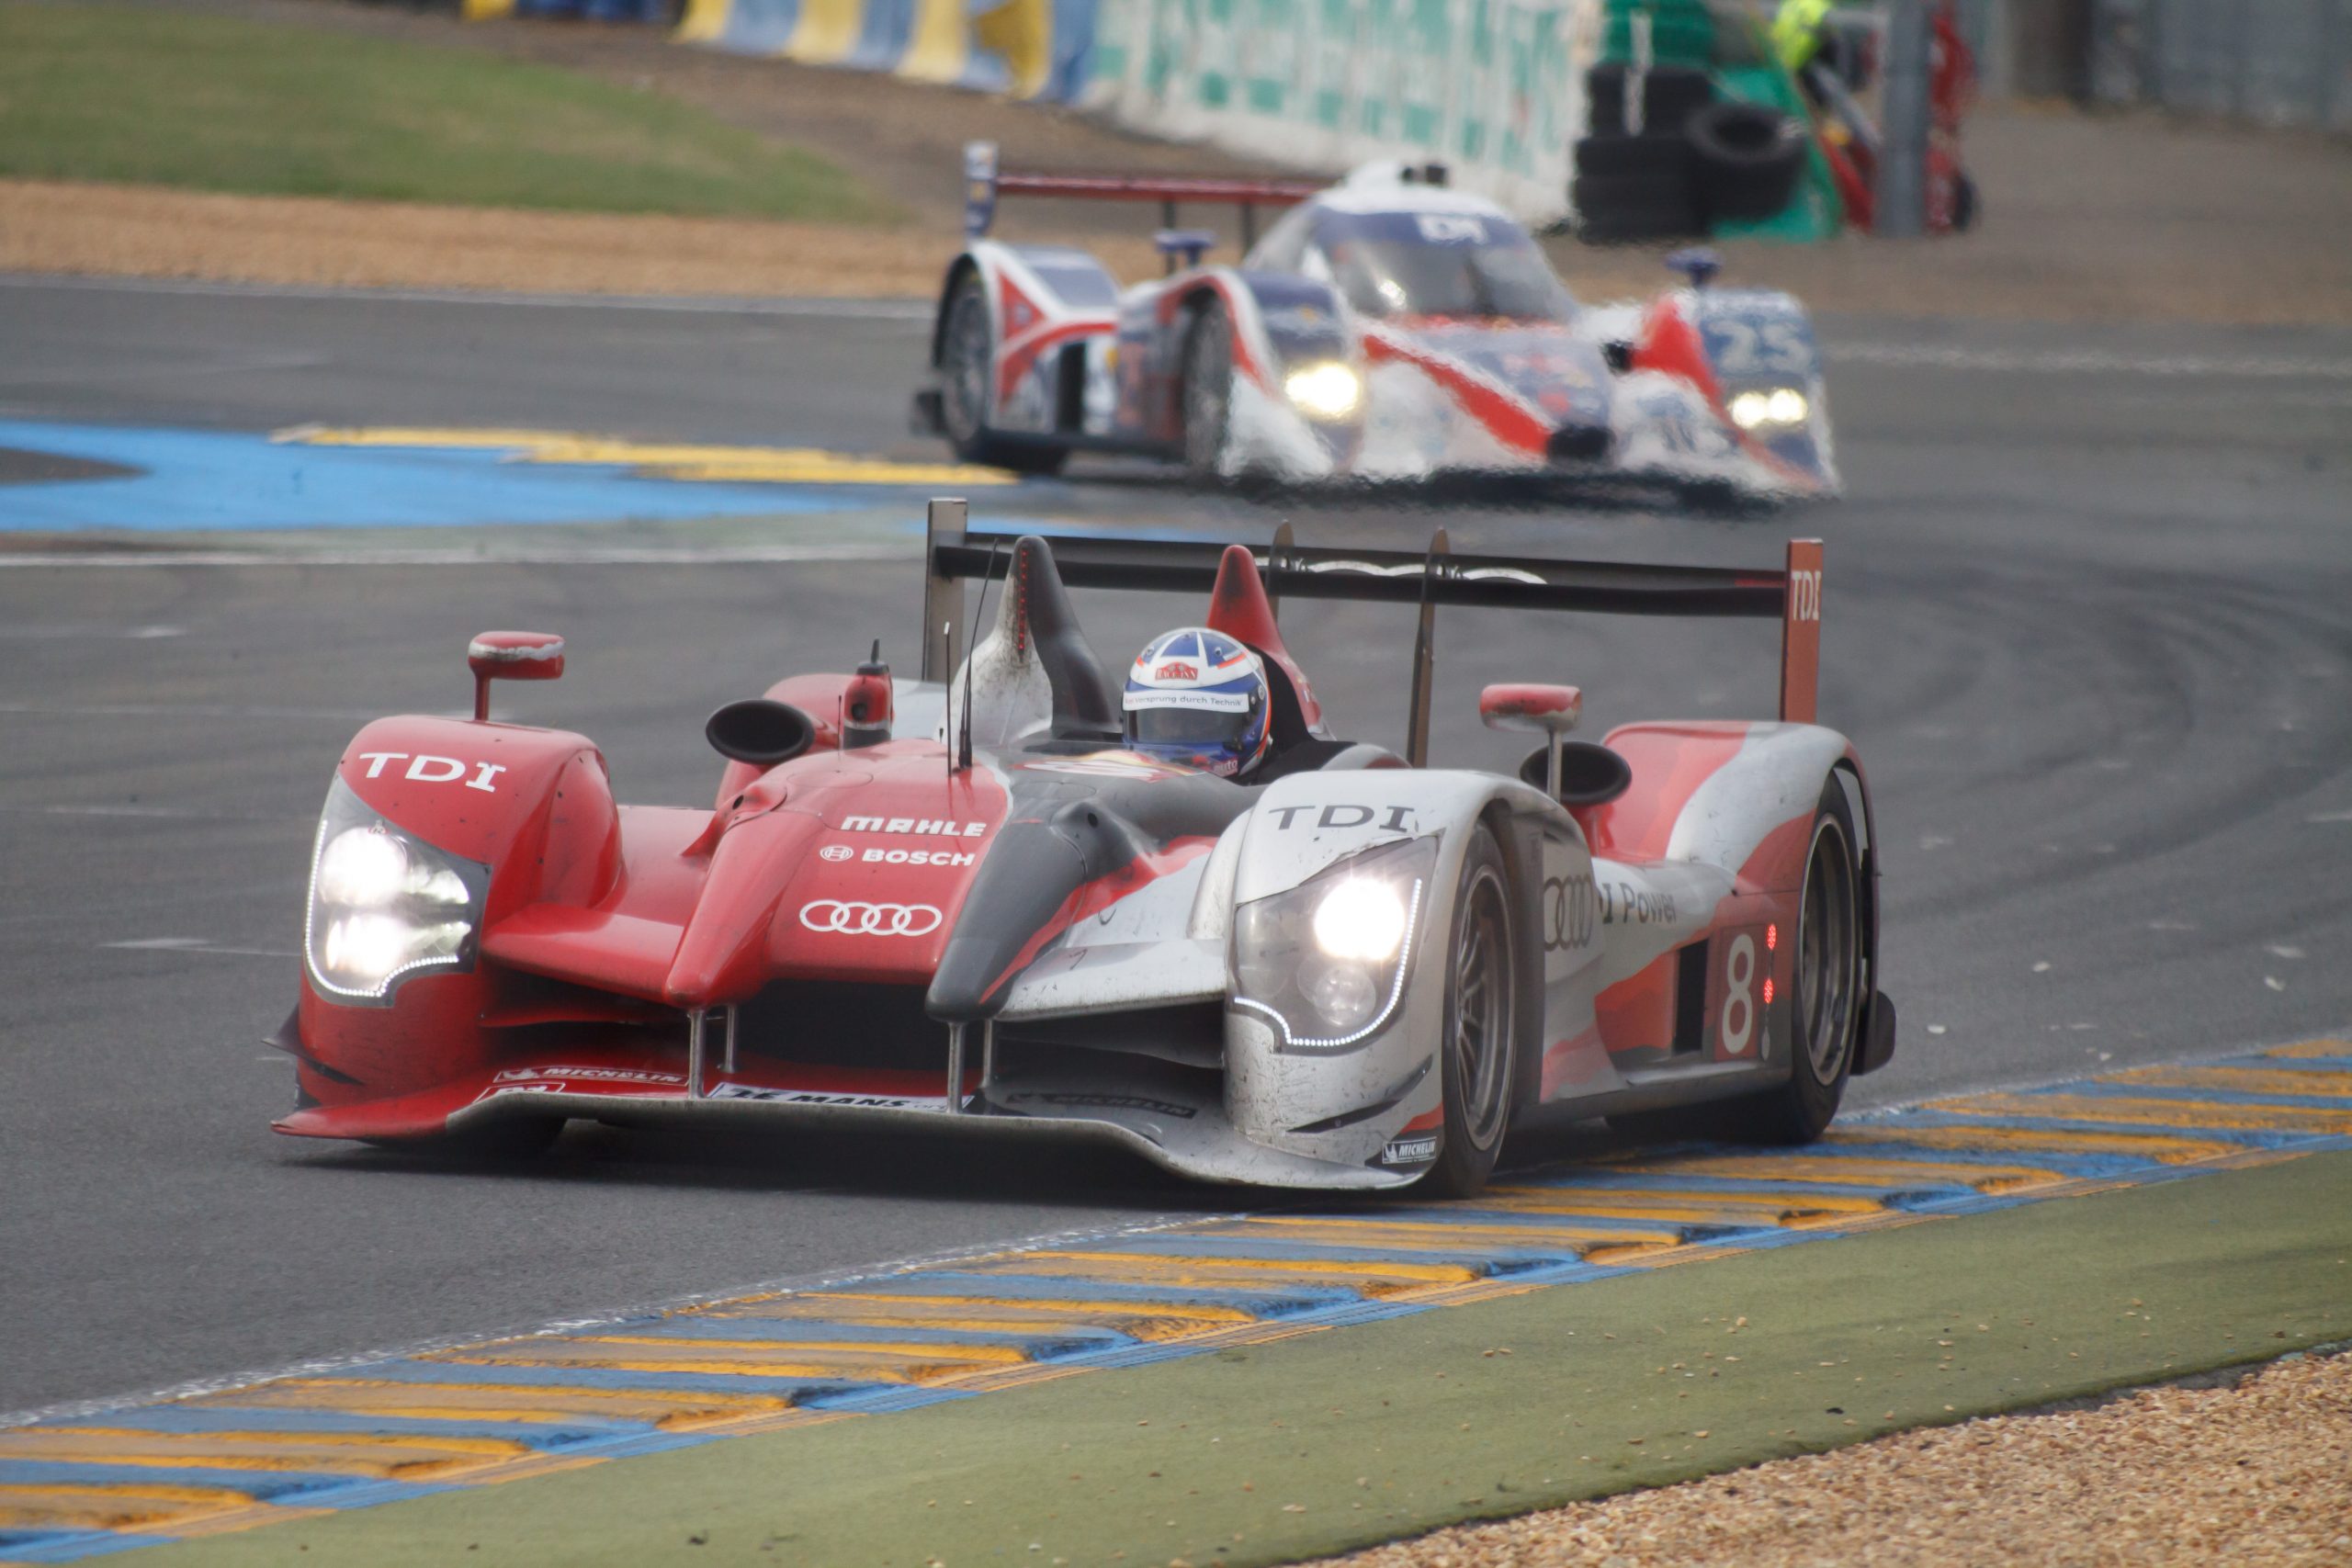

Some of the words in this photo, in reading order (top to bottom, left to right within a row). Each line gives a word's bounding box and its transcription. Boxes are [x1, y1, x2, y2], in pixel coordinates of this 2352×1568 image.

[1707, 321, 1813, 372] 25
[1791, 570, 1822, 621] TDI
[1180, 695, 1208, 705] durch
[1210, 697, 1243, 706] Technik
[358, 752, 507, 793] TDI
[840, 816, 987, 838] MAHLE
[1268, 805, 1414, 832] TDI
[861, 849, 977, 866] BOSCH
[1618, 883, 1677, 924] Power
[1722, 933, 1755, 1054] 8
[543, 1067, 683, 1083] MICHELIN
[786, 1095, 911, 1108] MANS
[1398, 1139, 1436, 1157] MICHELIN
